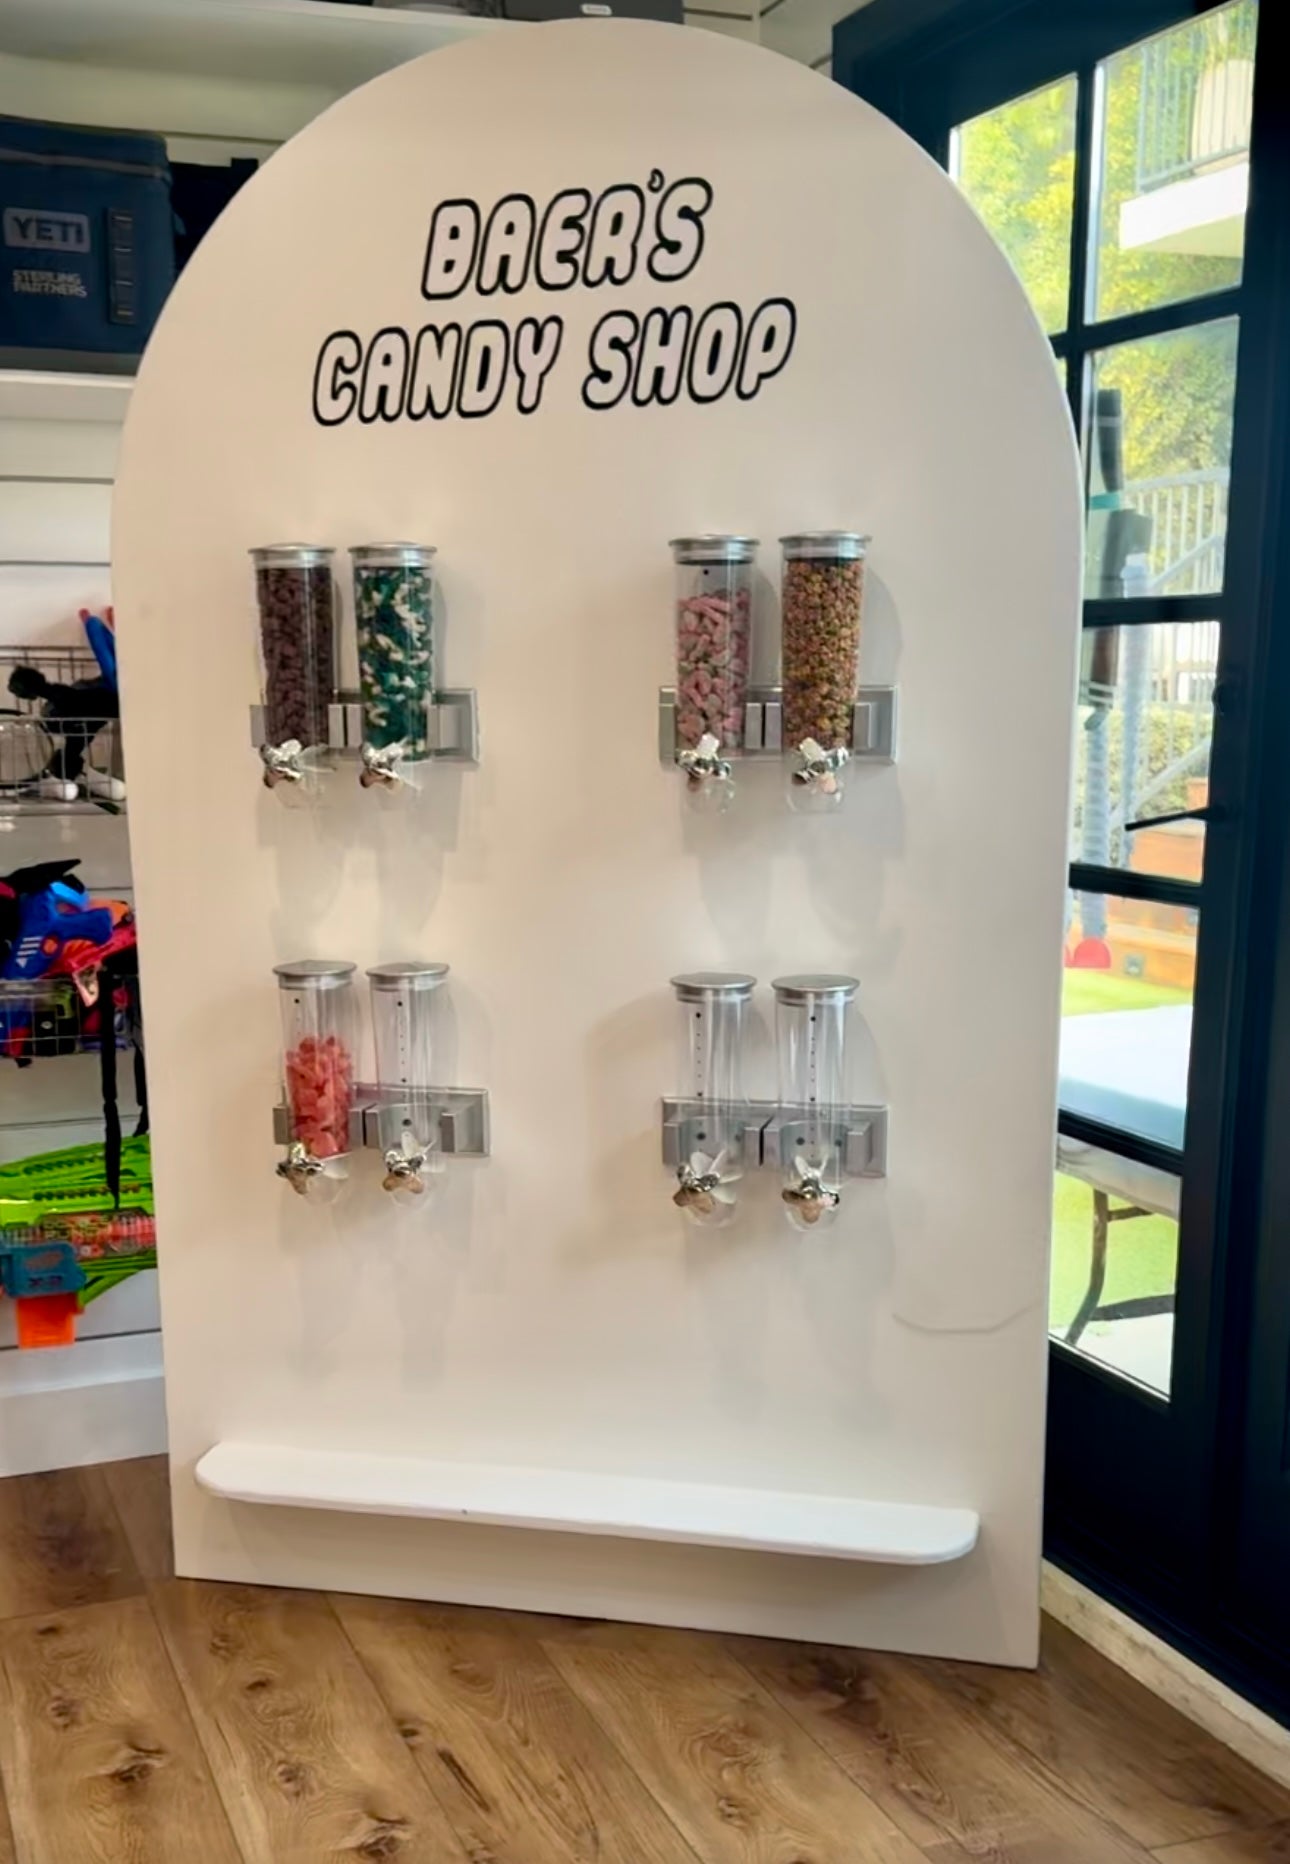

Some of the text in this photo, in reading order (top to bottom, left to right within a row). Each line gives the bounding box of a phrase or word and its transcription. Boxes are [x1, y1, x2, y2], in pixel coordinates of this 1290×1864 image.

[14, 216, 84, 243] YETI
[421, 168, 713, 300] BAER'S
[14, 282, 88, 297] PARTNERS
[313, 297, 796, 426] CANDY SHOP
